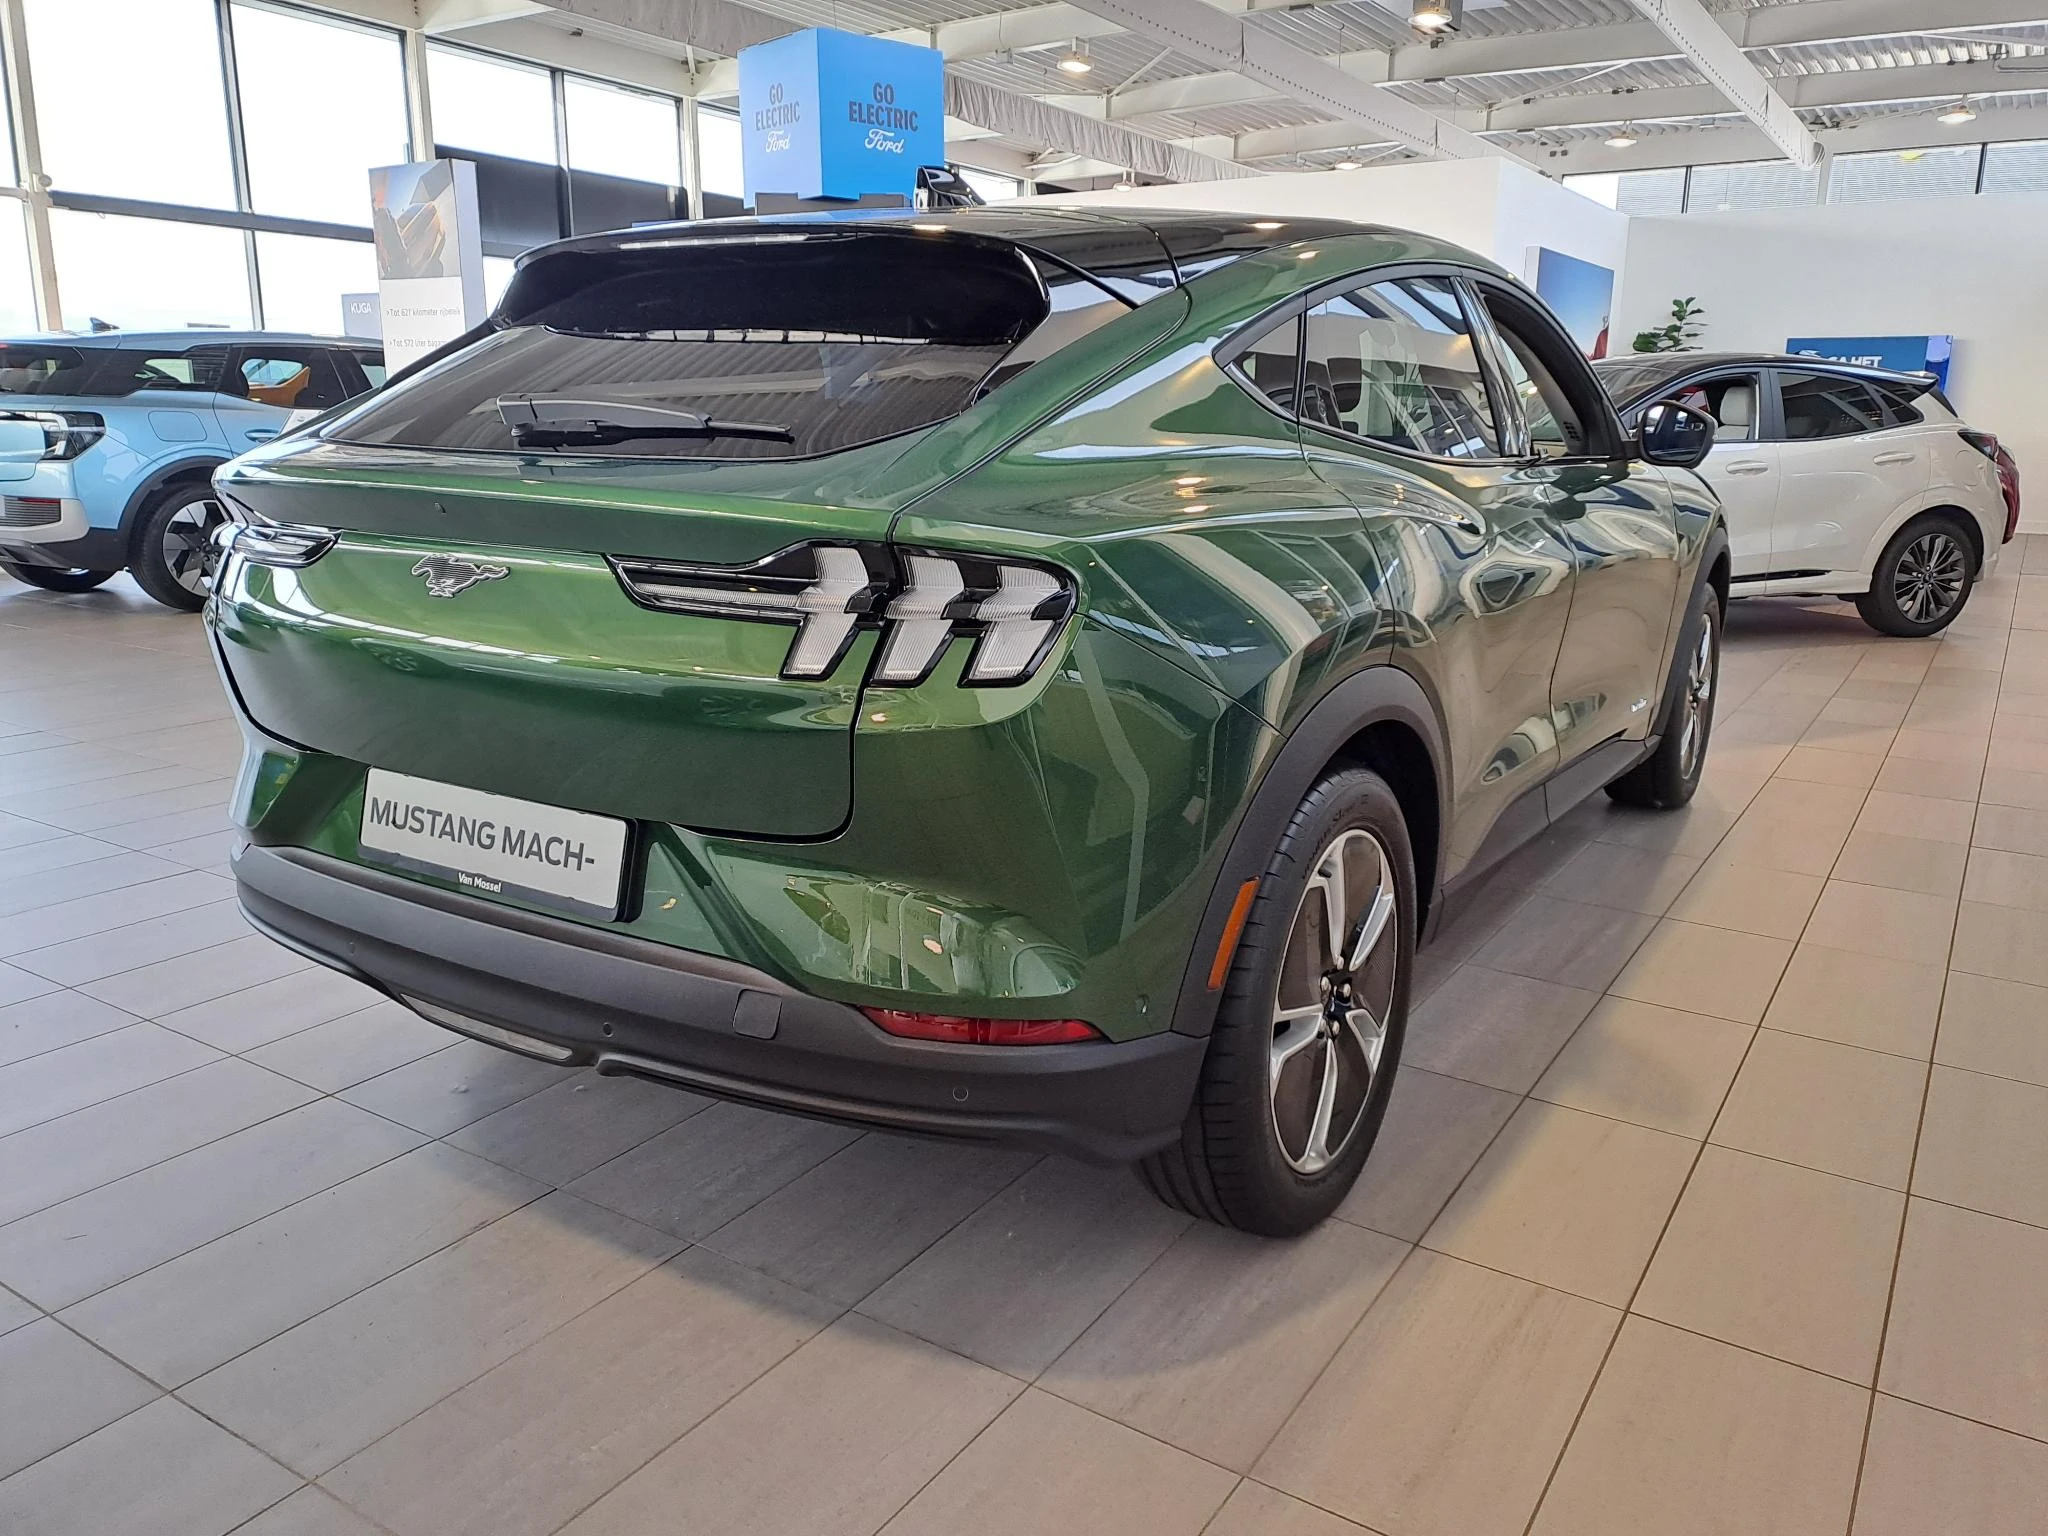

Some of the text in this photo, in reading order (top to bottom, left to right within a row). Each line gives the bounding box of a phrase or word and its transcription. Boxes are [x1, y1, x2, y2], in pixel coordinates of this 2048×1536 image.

[769, 82, 784, 106] GO
[873, 81, 895, 106] GO
[755, 100, 800, 131] ELECTRIC
[848, 100, 919, 132] ELECTRIC
[765, 129, 792, 152] Ford
[864, 128, 905, 154] Ford
[350, 302, 372, 314] KUGA
[370, 797, 595, 872] MUSTANG MACH-
[458, 872, 502, 893] Van Mossel
